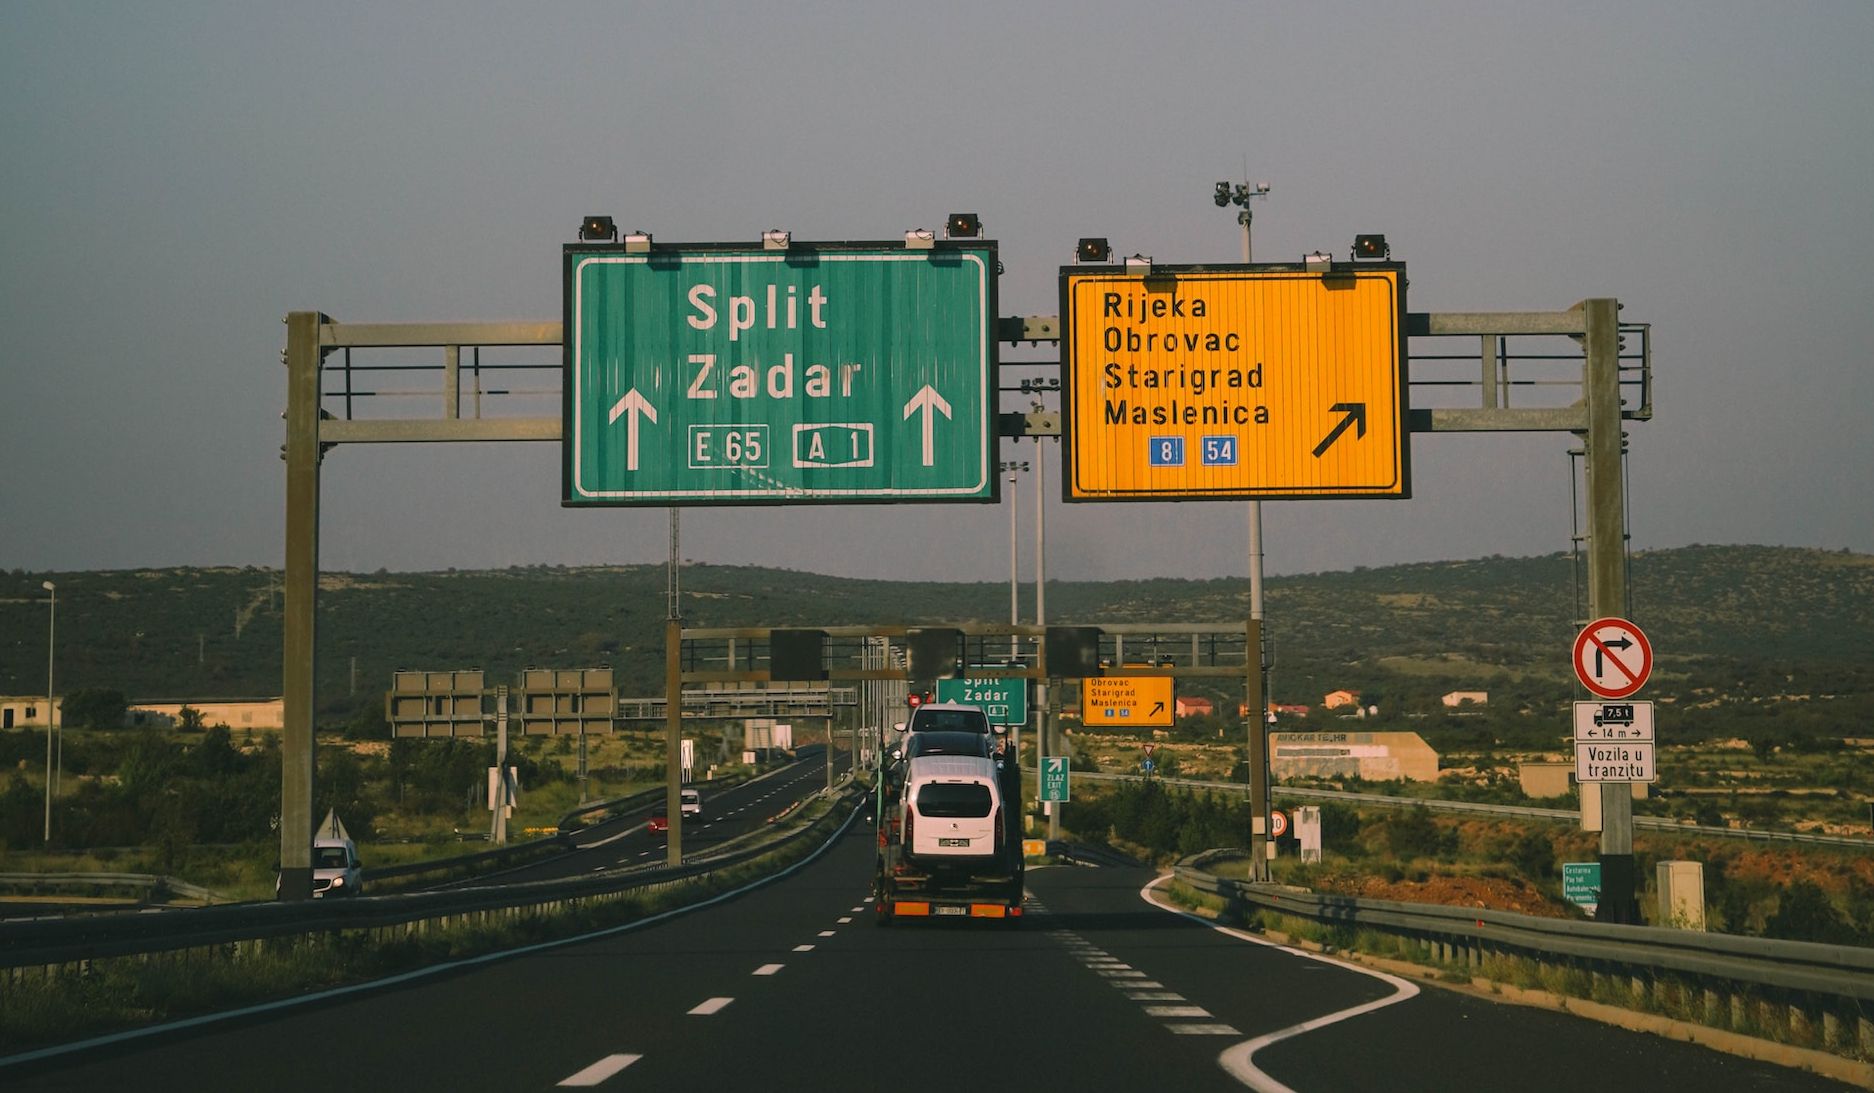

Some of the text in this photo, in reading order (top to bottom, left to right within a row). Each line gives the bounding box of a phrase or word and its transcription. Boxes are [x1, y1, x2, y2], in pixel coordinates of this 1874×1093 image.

[687, 284, 827, 341] Split
[1104, 292, 1207, 323] Rijeka
[1104, 326, 1241, 352] Obrovac
[687, 353, 861, 399] Zadar
[1104, 363, 1263, 395] Starigrad
[1104, 400, 1270, 425] Maslenica
[696, 432, 761, 461] E 65
[808, 432, 859, 460] A 1
[1161, 441, 1171, 461] 8
[1207, 440, 1232, 461] 54
[964, 689, 1008, 701] Zadar
[1091, 688, 1135, 698] Starigrad
[1607, 708, 1622, 718] 7,5
[1602, 728, 1627, 738] 14 m
[1588, 747, 1642, 761] Vozila u
[1589, 764, 1643, 777] tranzitu
